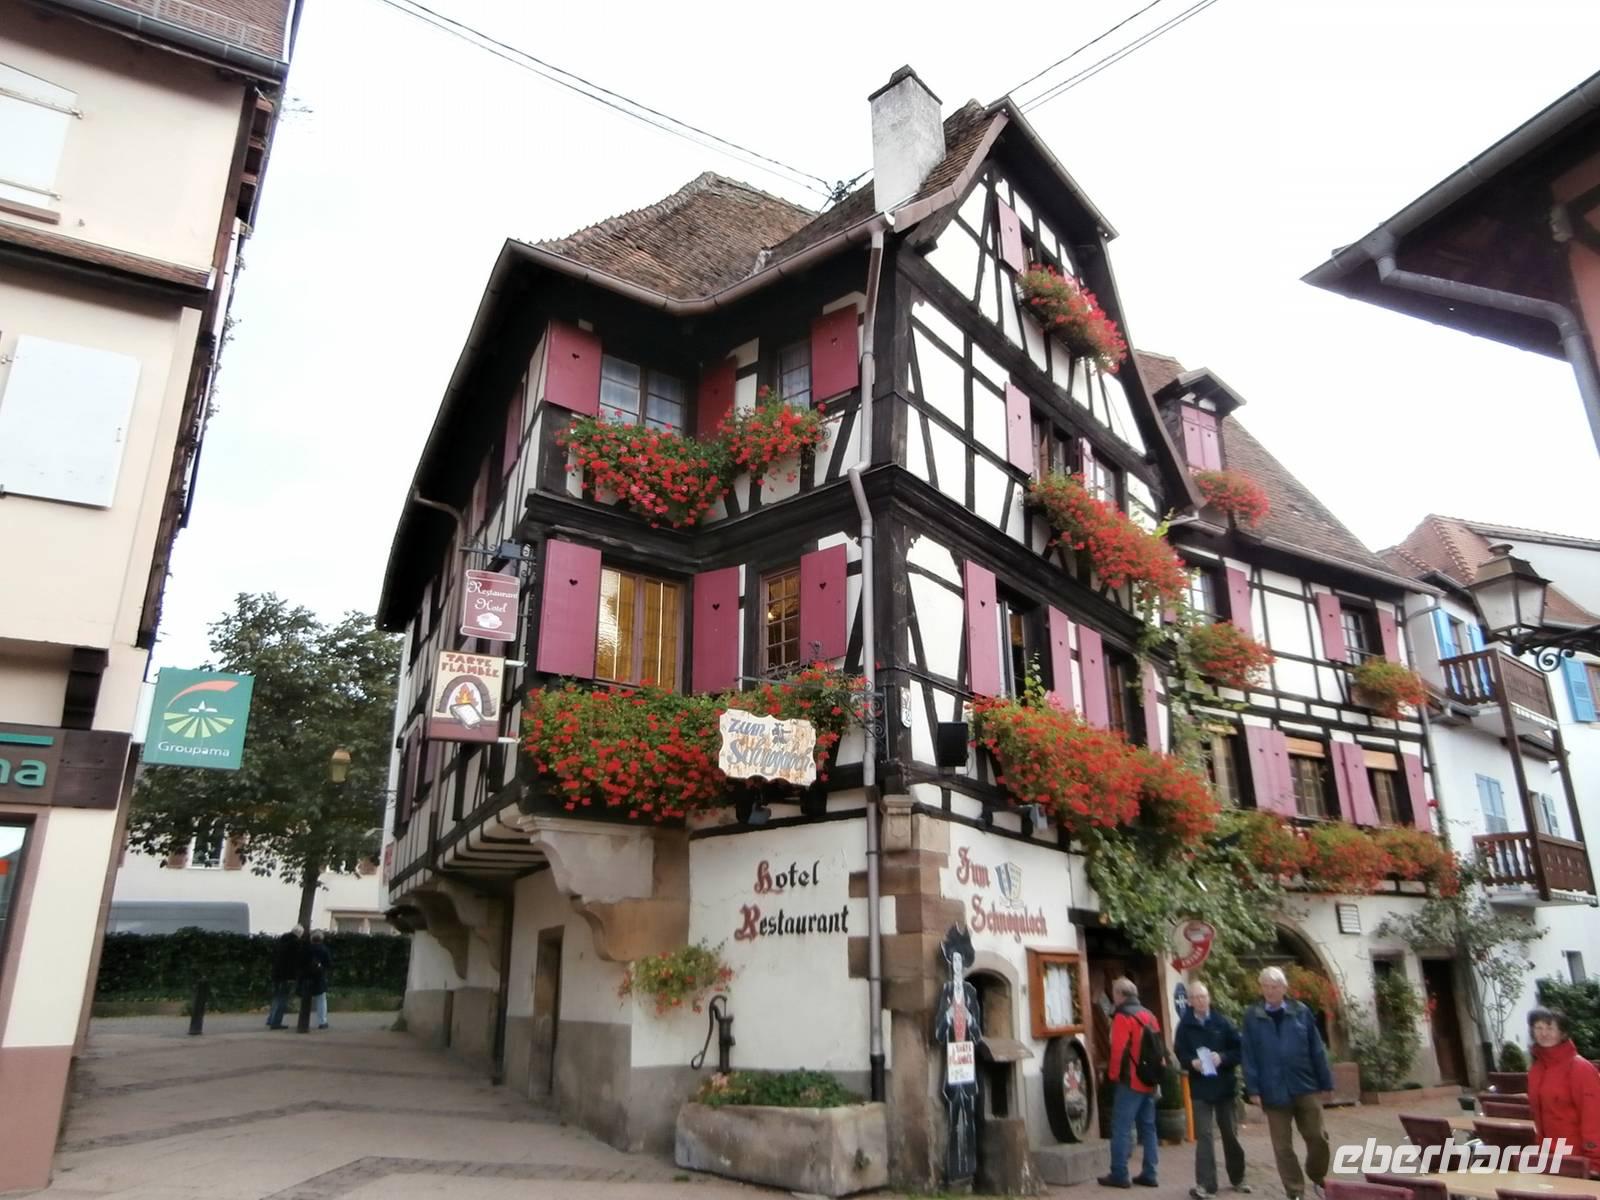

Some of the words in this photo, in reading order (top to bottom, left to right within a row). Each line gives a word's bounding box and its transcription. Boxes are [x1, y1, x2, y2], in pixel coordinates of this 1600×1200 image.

[474, 598, 508, 613] Hotel
[446, 654, 491, 667] TARTE
[728, 718, 766, 736] Zum
[157, 741, 230, 757] Groupama
[754, 860, 820, 894] Hotel
[734, 903, 849, 941] Restaurant
